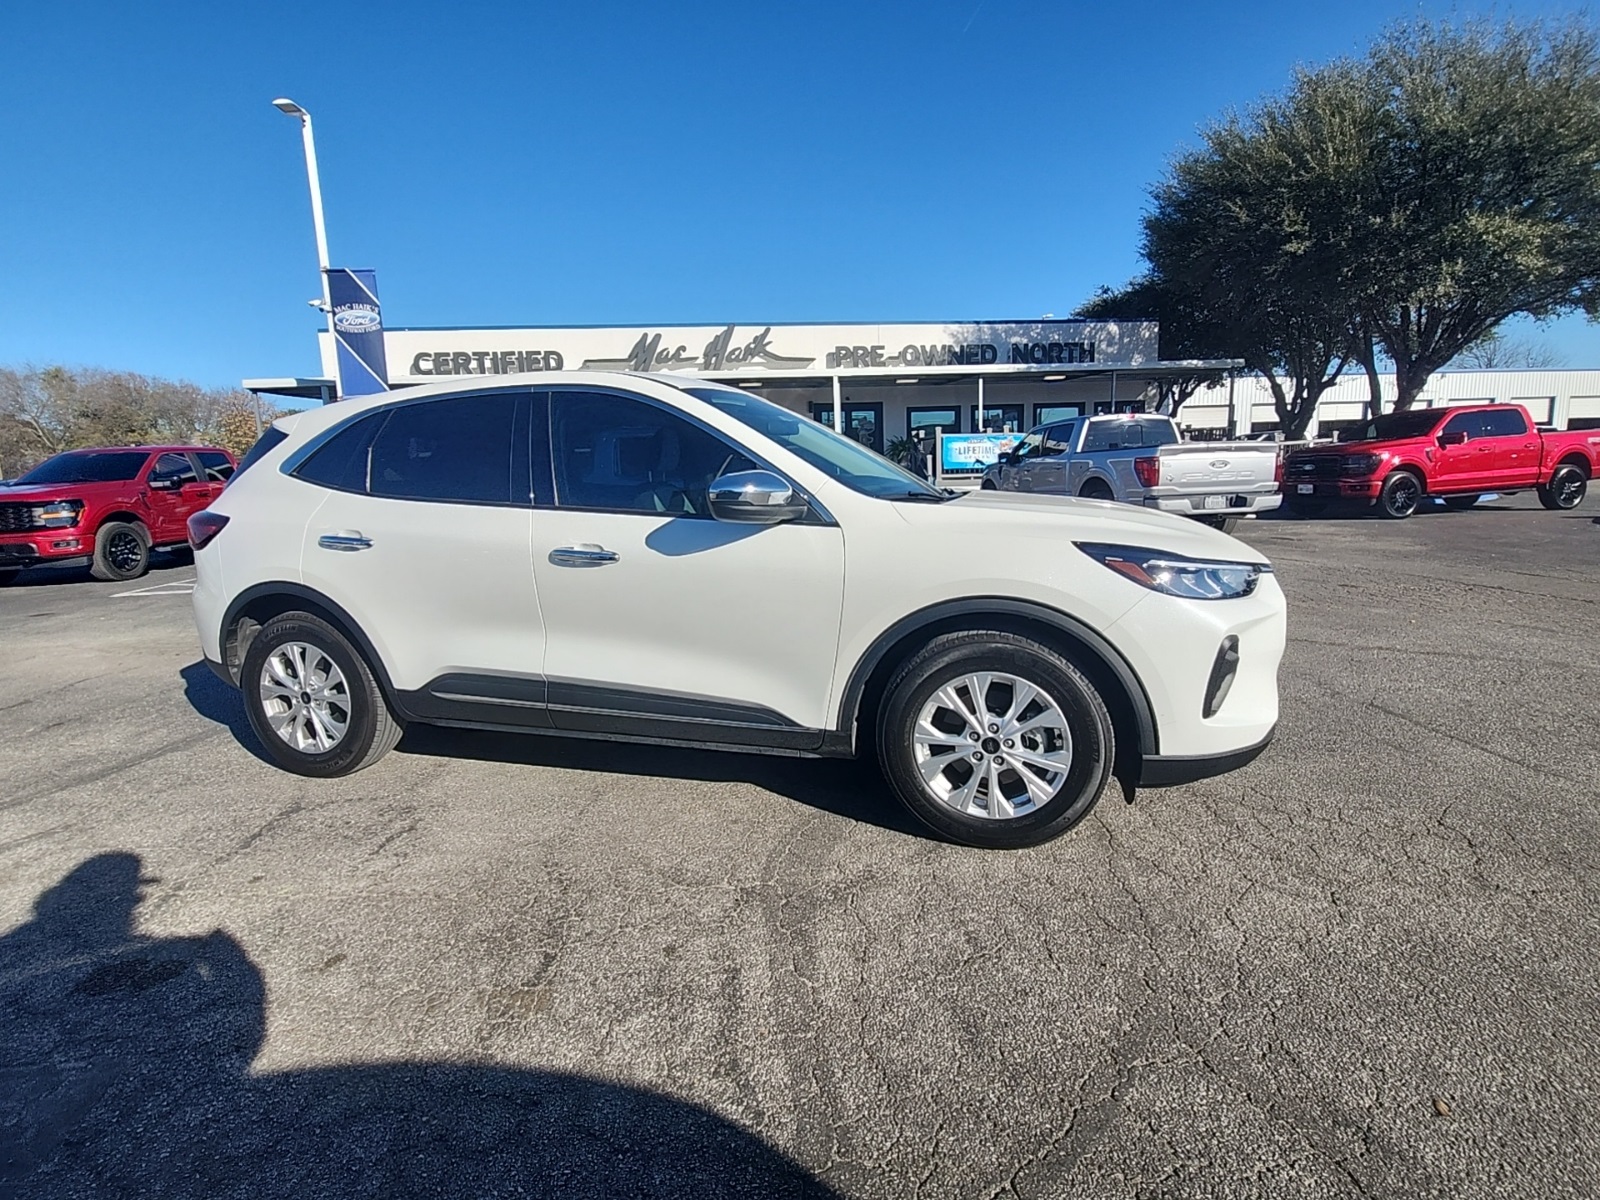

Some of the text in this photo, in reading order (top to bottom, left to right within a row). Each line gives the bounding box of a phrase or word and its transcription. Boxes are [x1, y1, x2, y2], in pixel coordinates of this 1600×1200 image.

[334, 303, 351, 314] MAC
[343, 314, 371, 325] Ford
[628, 323, 773, 372] Mac Haik
[834, 341, 1096, 367] PRE-OWNED NORTH
[412, 350, 564, 375] CERTIFIED
[958, 446, 996, 455] LIFETIME
